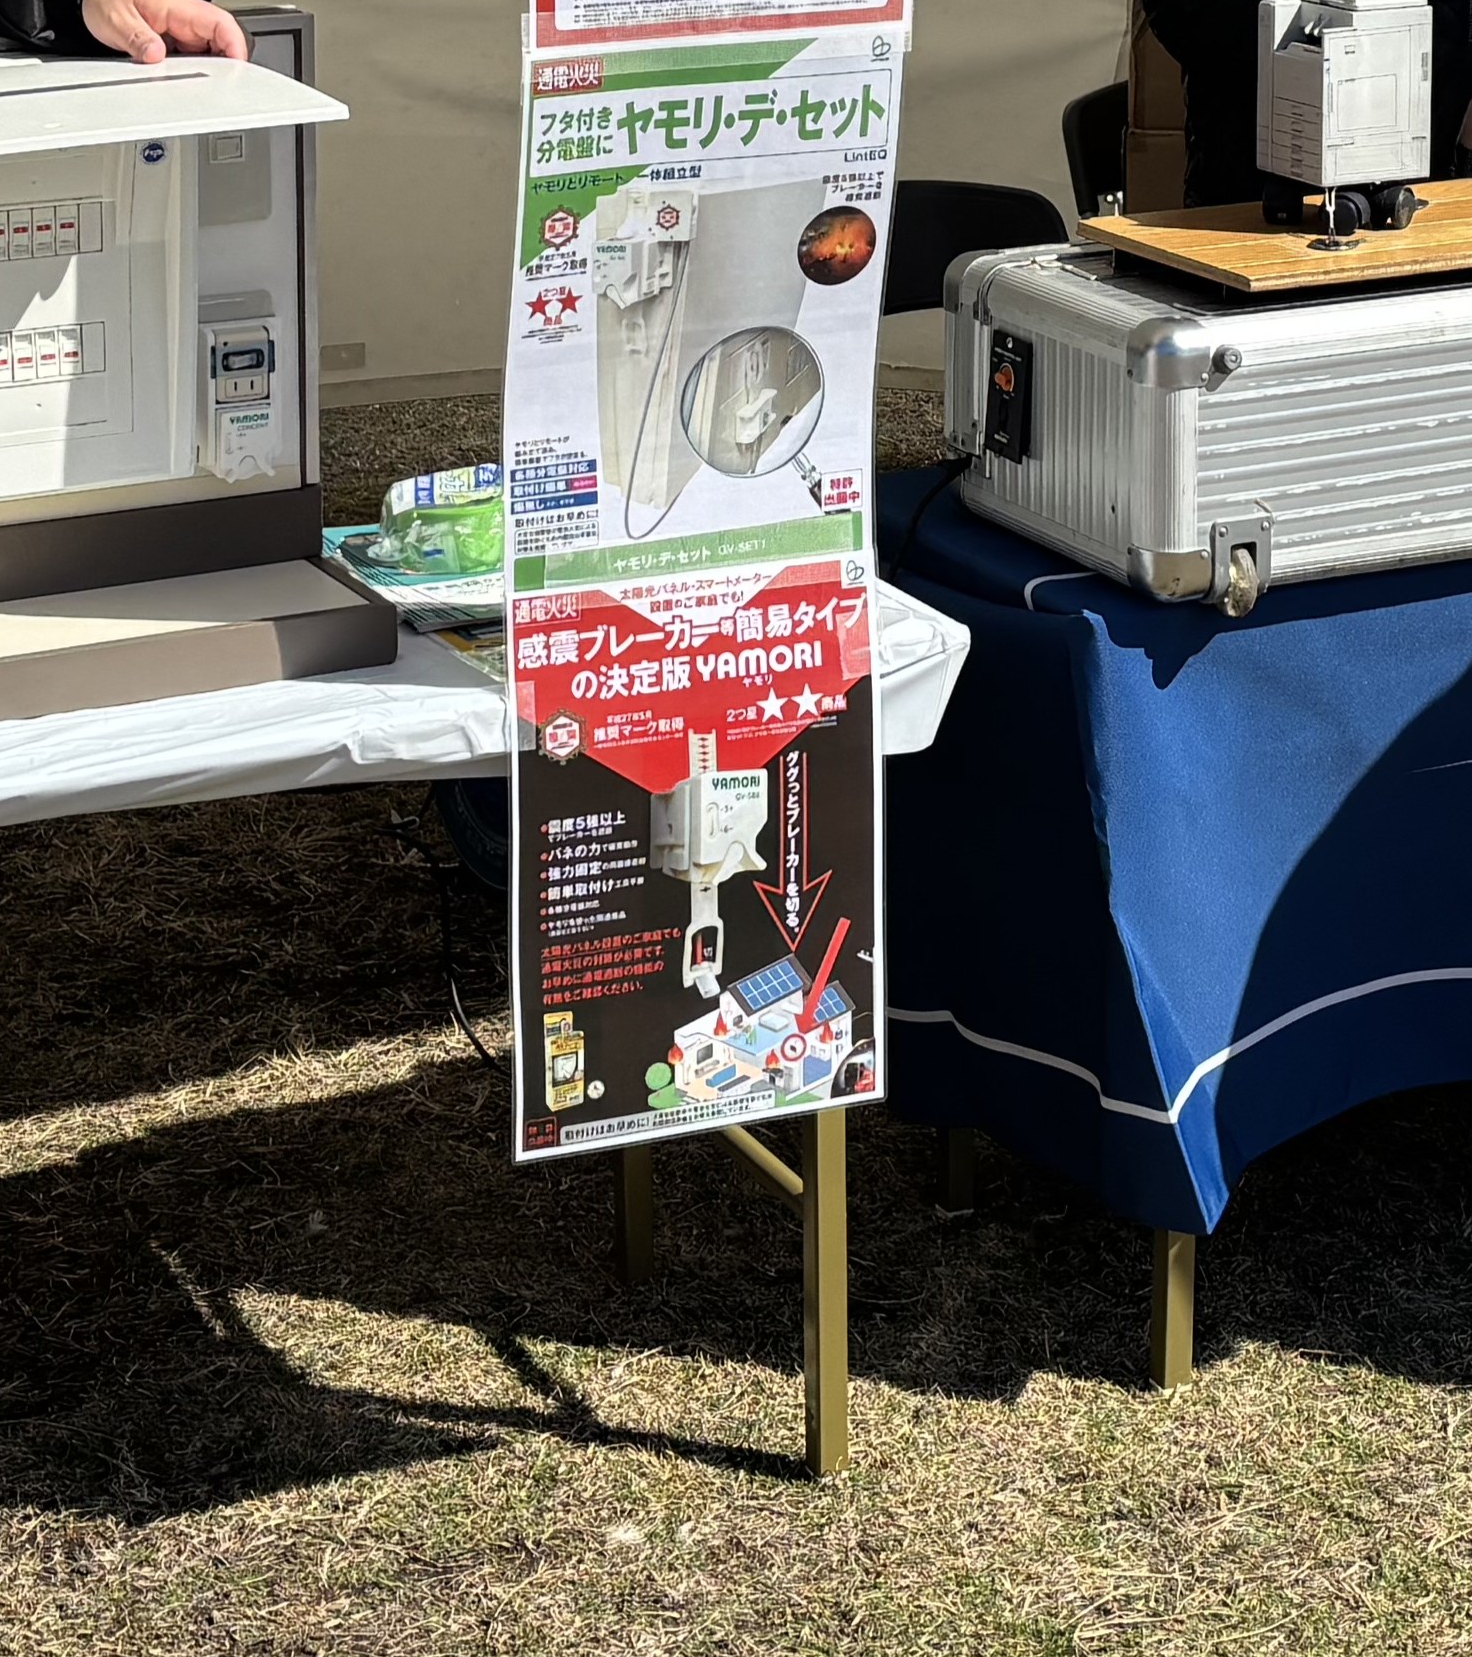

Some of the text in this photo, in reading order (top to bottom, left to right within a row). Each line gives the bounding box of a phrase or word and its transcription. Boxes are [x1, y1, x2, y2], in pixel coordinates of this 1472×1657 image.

[539, 106, 614, 135] フタ付き
[617, 84, 886, 155] ヤモリ・デ・セット
[536, 135, 614, 164] 分電盤に
[531, 172, 625, 195] ヤモリとリモート
[613, 546, 712, 574] ヤモリ・デ・セット
[517, 592, 868, 670] 感震ブレーカー等簡易タイプ
[571, 641, 823, 701] の決定版 YAMORI
[712, 775, 761, 790] YAMORI
